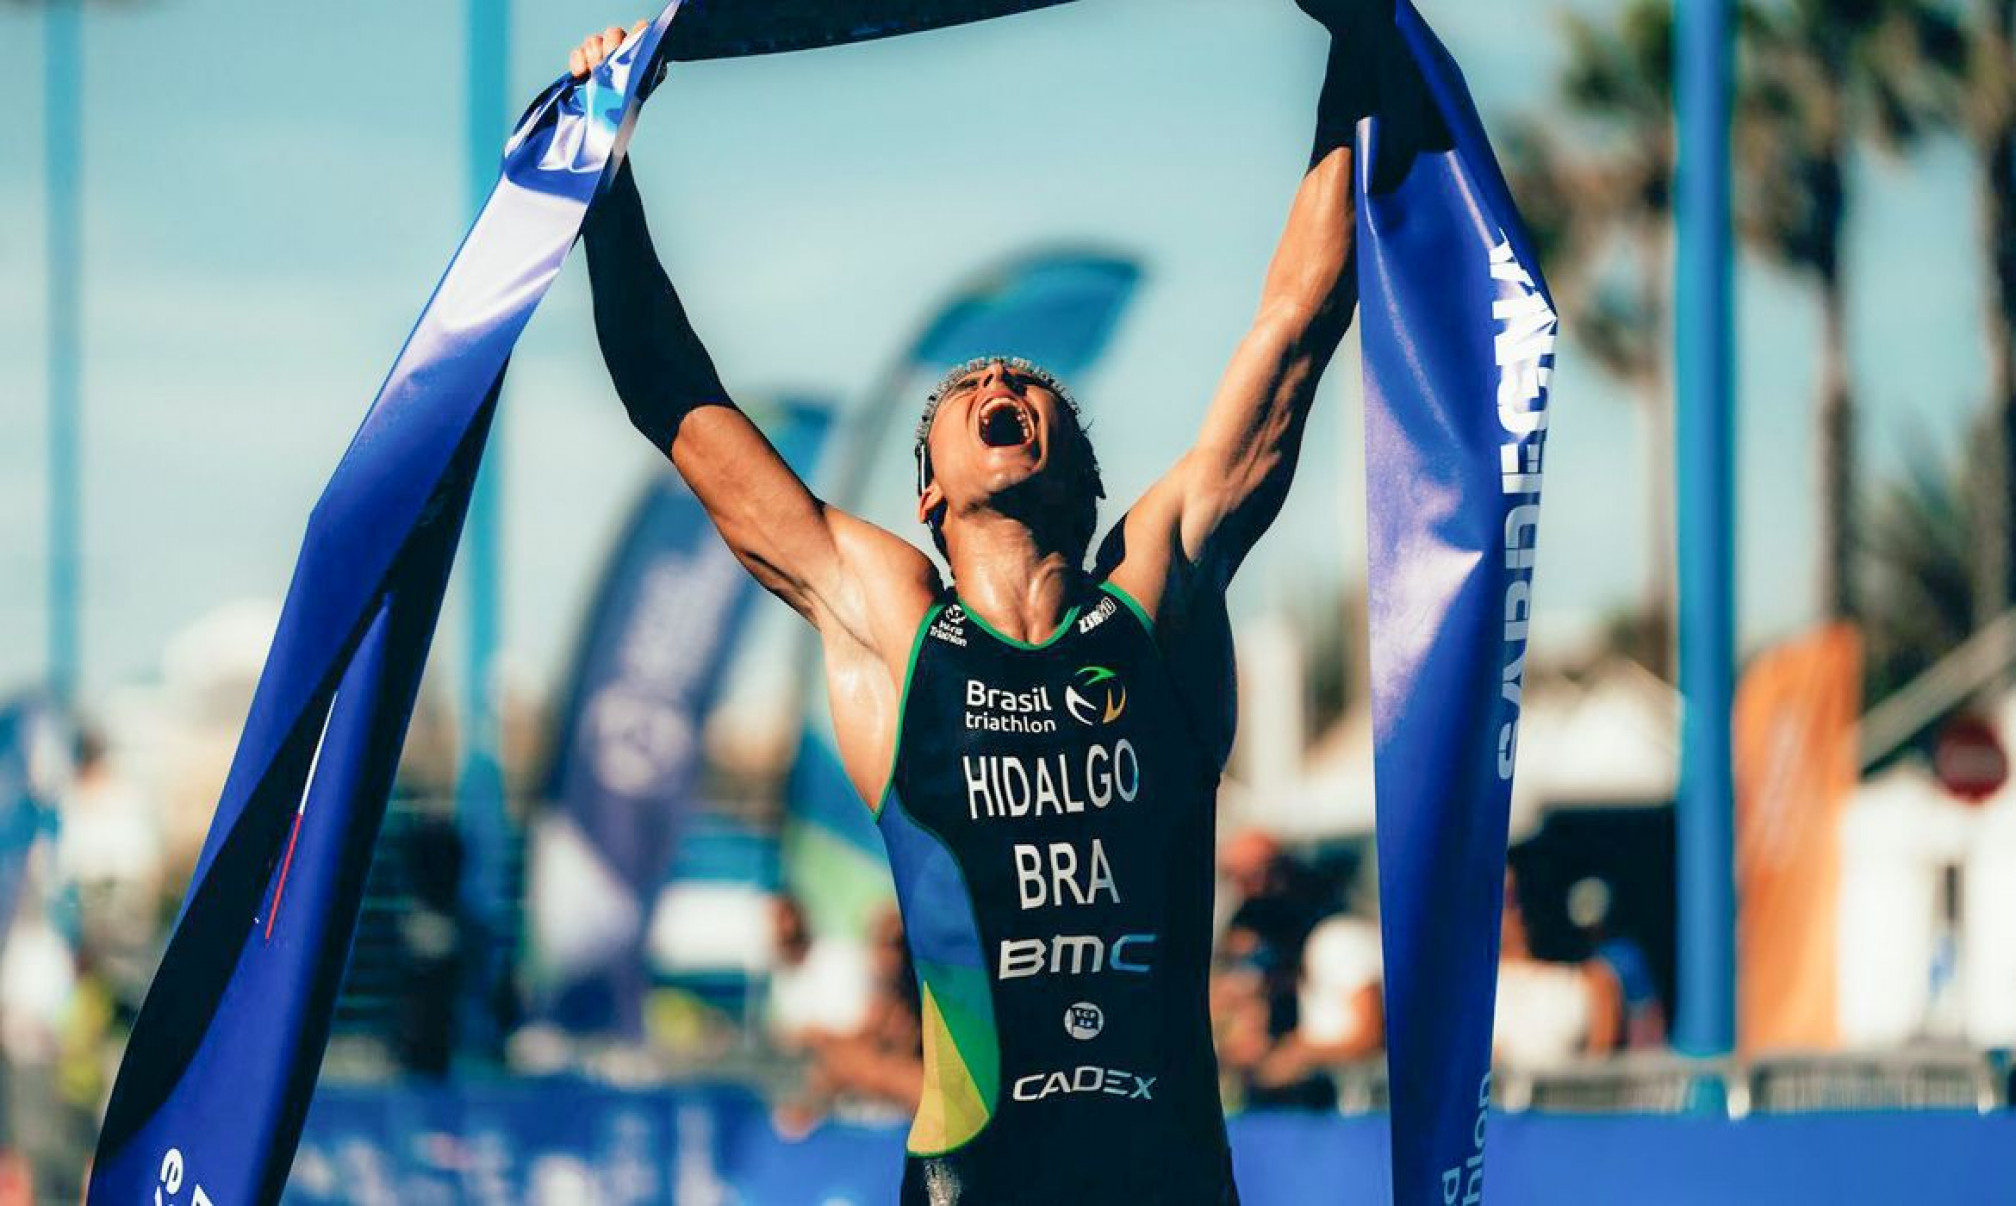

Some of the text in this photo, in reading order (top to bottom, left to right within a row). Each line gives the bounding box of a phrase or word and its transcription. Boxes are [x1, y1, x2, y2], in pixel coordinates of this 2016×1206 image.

[965, 679, 1052, 713] Brasil
[965, 710, 1057, 733] triathlon
[962, 738, 1139, 820] HIDALGO
[1014, 838, 1120, 910] BRA
[999, 933, 1157, 980] BMC
[1013, 1065, 1157, 1102] CADEX
